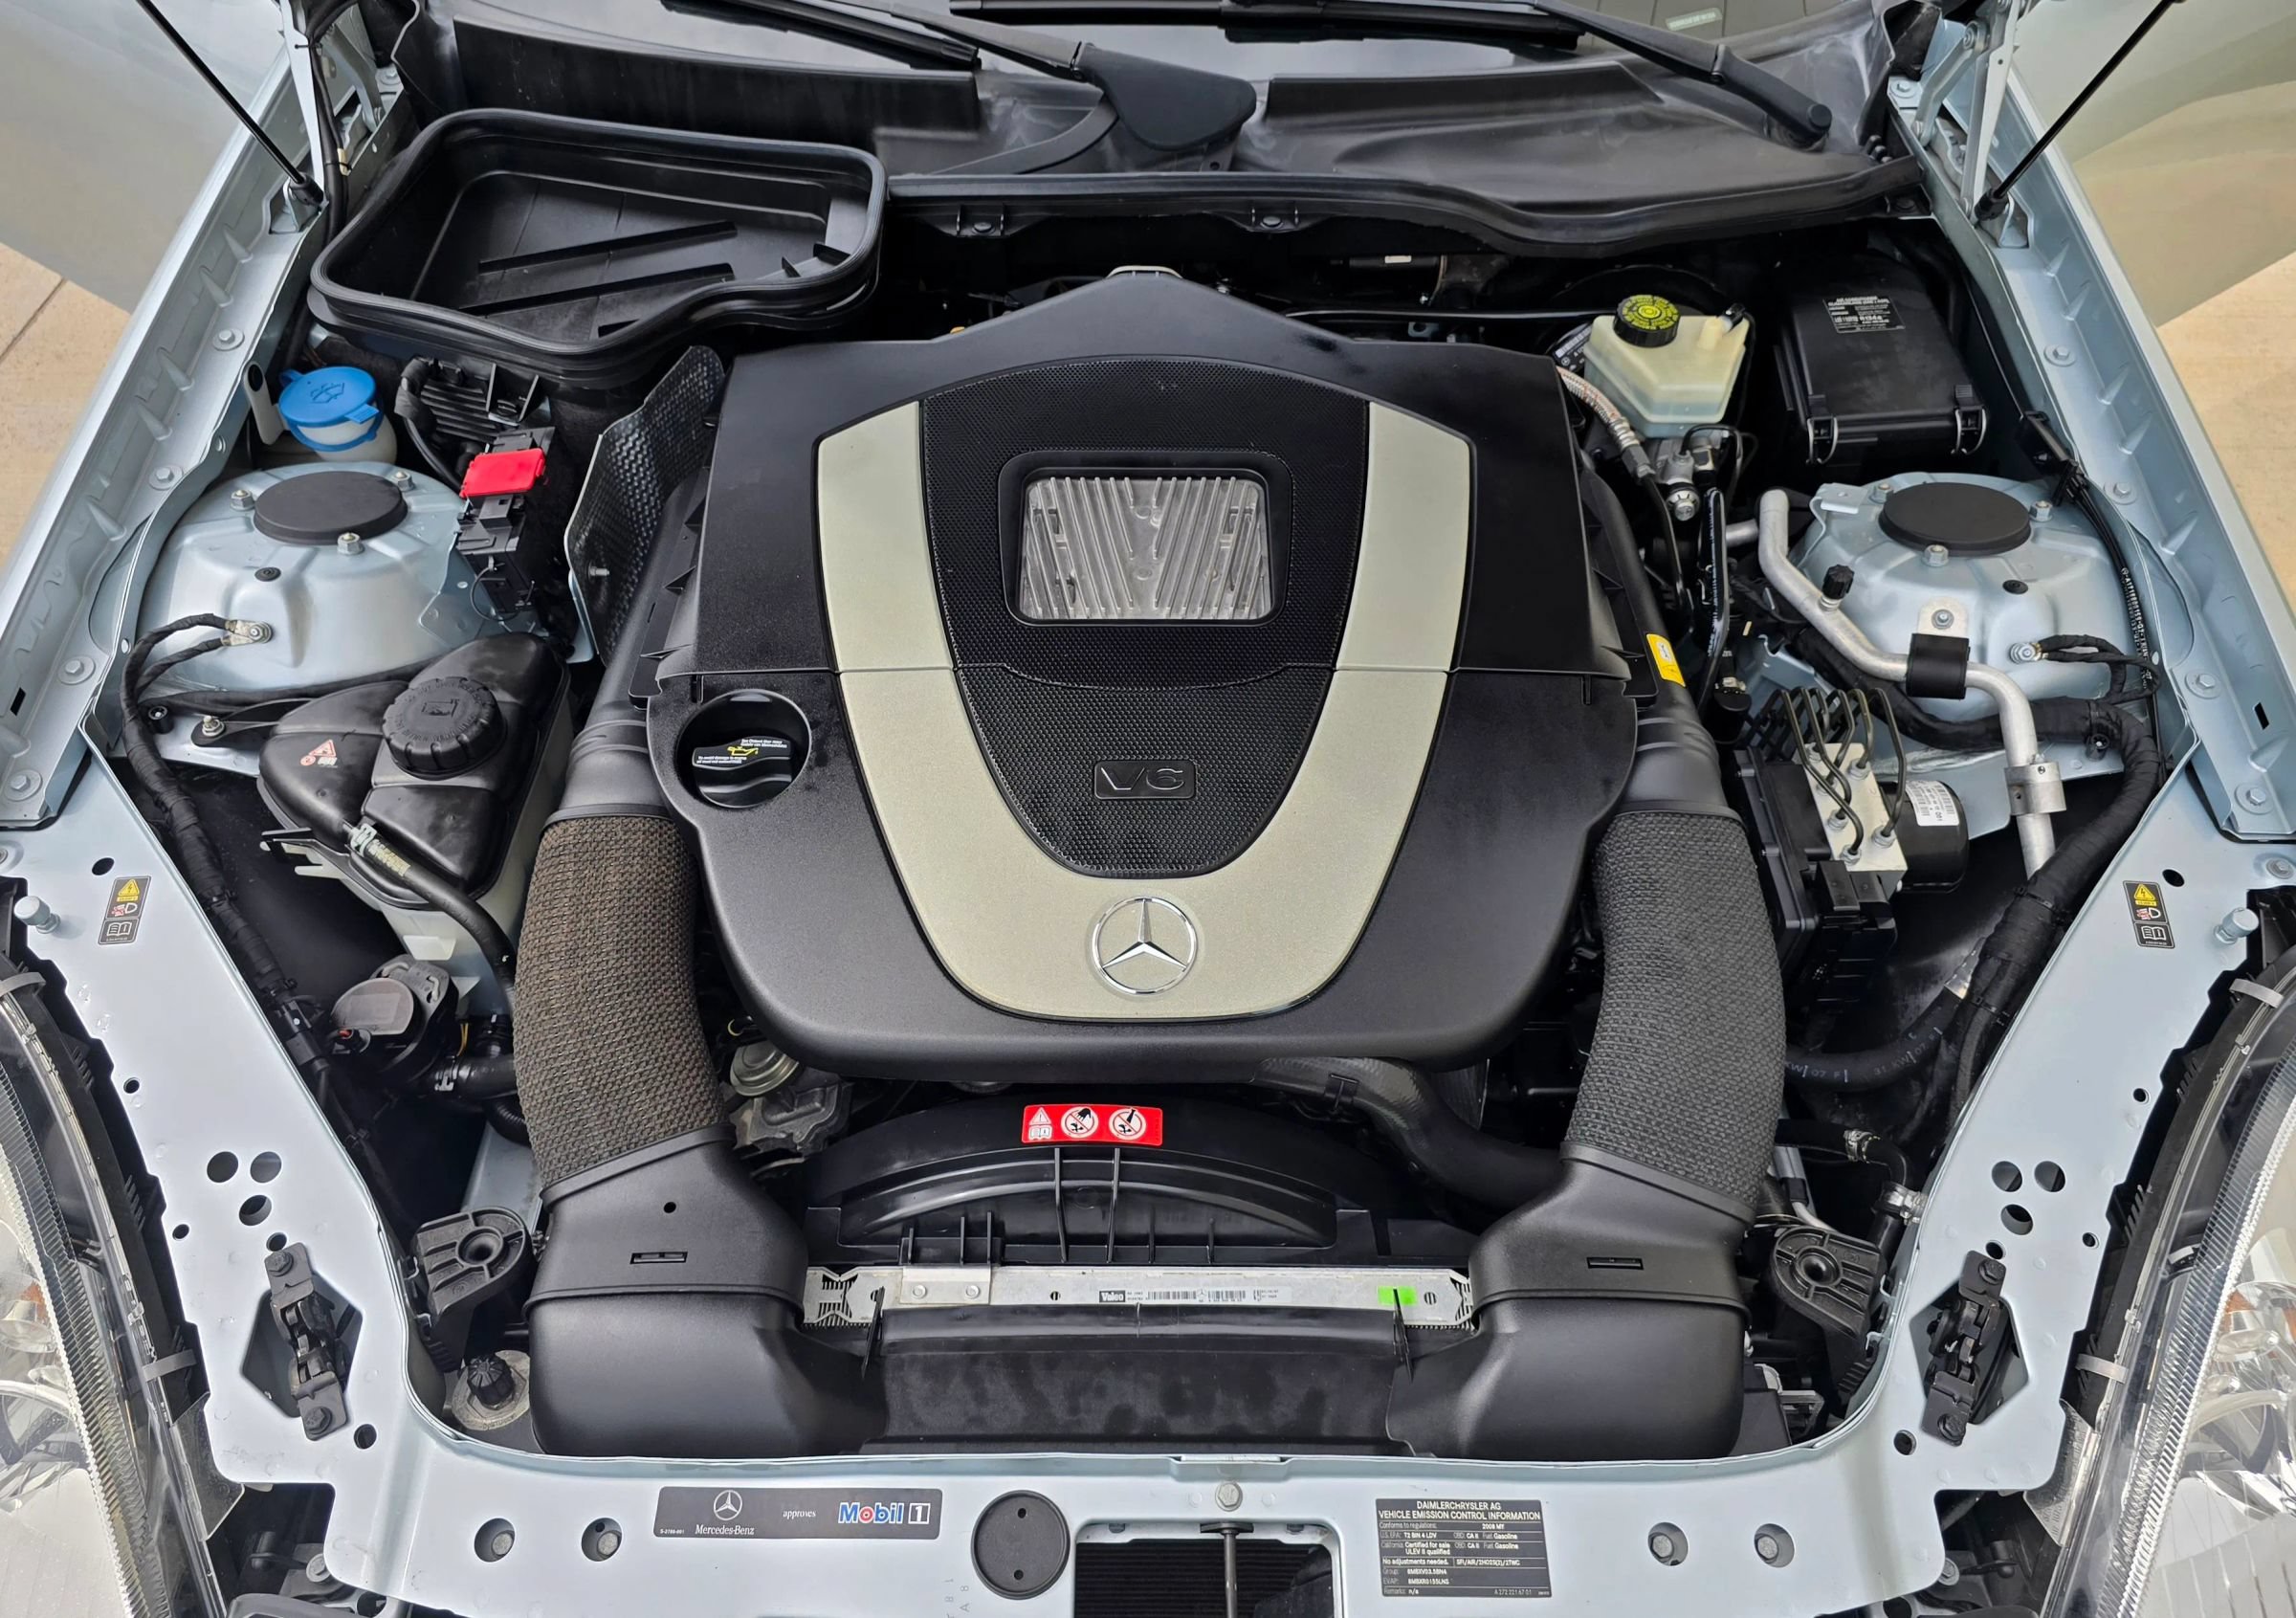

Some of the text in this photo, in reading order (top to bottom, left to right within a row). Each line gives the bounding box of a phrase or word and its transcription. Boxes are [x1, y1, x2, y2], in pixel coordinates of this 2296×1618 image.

[1100, 766, 1185, 790] V6
[1101, 1292, 1124, 1301] Valeo
[1417, 1500, 1502, 1510] DAIMLERCHRYSLER AG
[783, 1508, 816, 1518] approves
[838, 1502, 904, 1523] Mobil
[1379, 1510, 1540, 1520] VEHICLE EMISSION CONTROL INFORMATION
[695, 1524, 755, 1535] Mercedes-Benz
